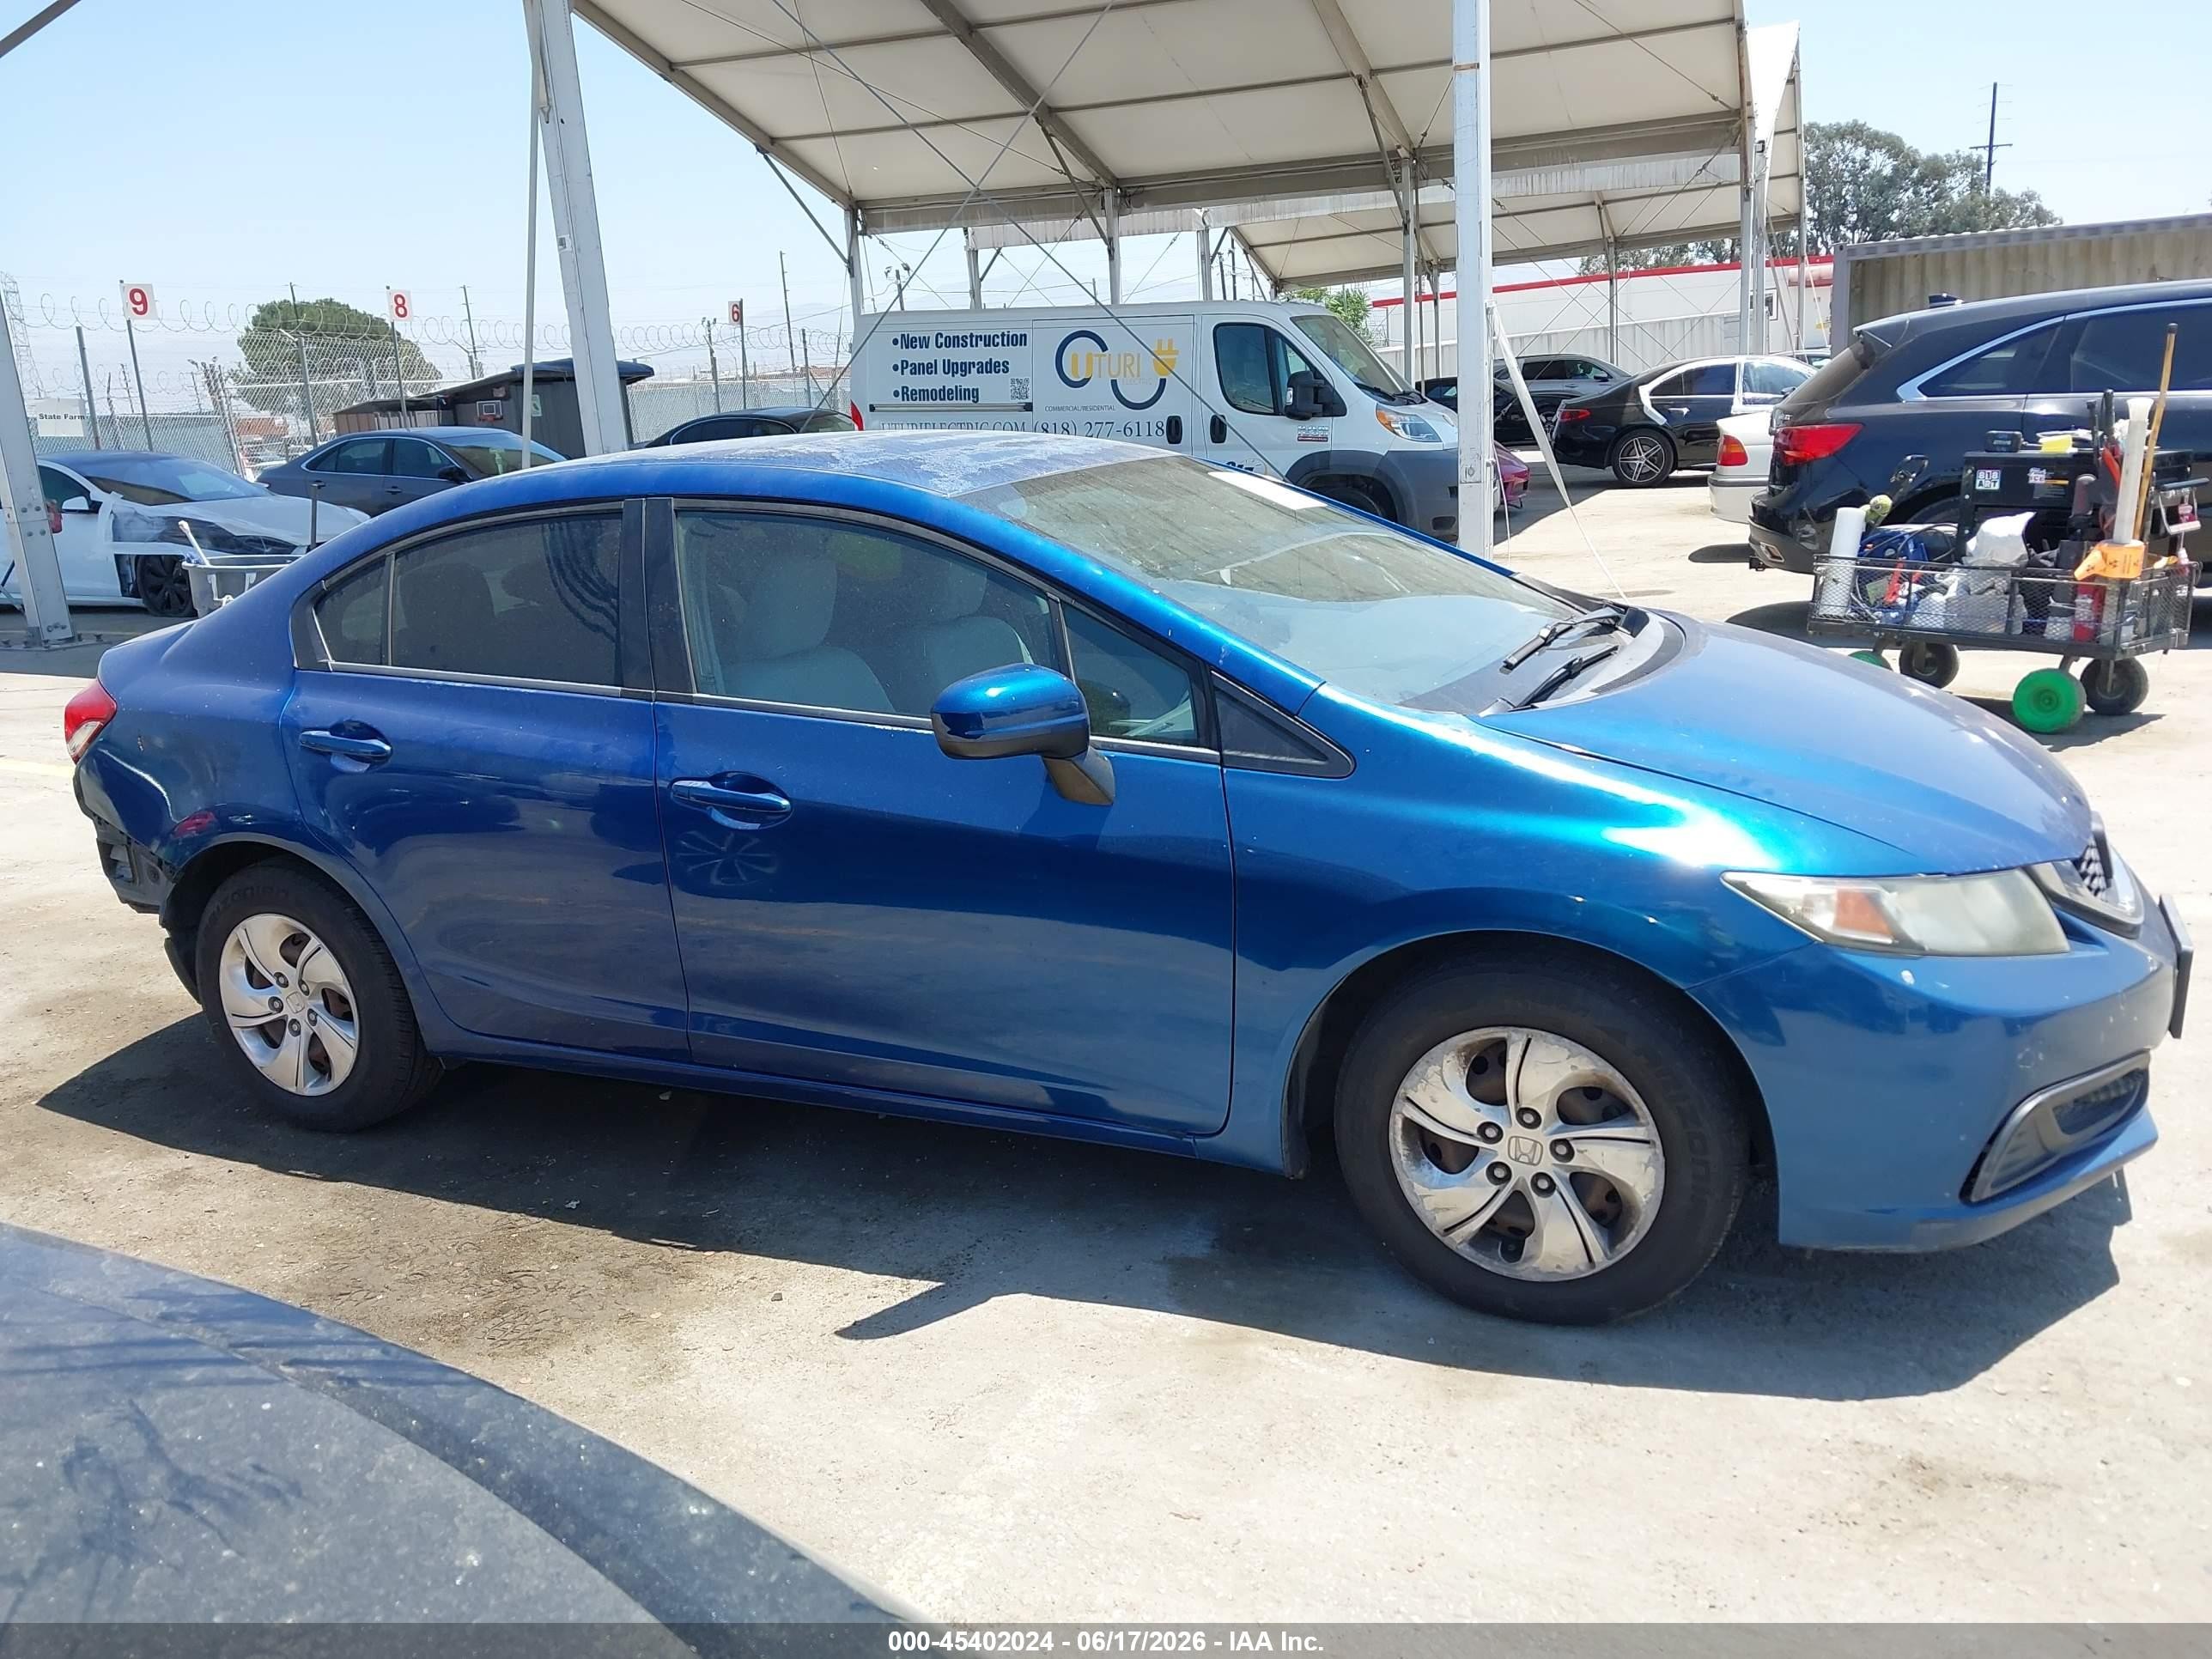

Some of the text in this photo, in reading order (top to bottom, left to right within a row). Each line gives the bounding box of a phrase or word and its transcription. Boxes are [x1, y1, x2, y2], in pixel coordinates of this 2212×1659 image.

[129, 288, 149, 316] 9
[393, 294, 408, 318] 8
[731, 303, 739, 322] 6
[900, 331, 1028, 349] New Construction
[900, 357, 1010, 378] Panel Upgrades
[901, 385, 980, 404] Remodeling
[1034, 420, 1164, 439] (818) 277-6118
